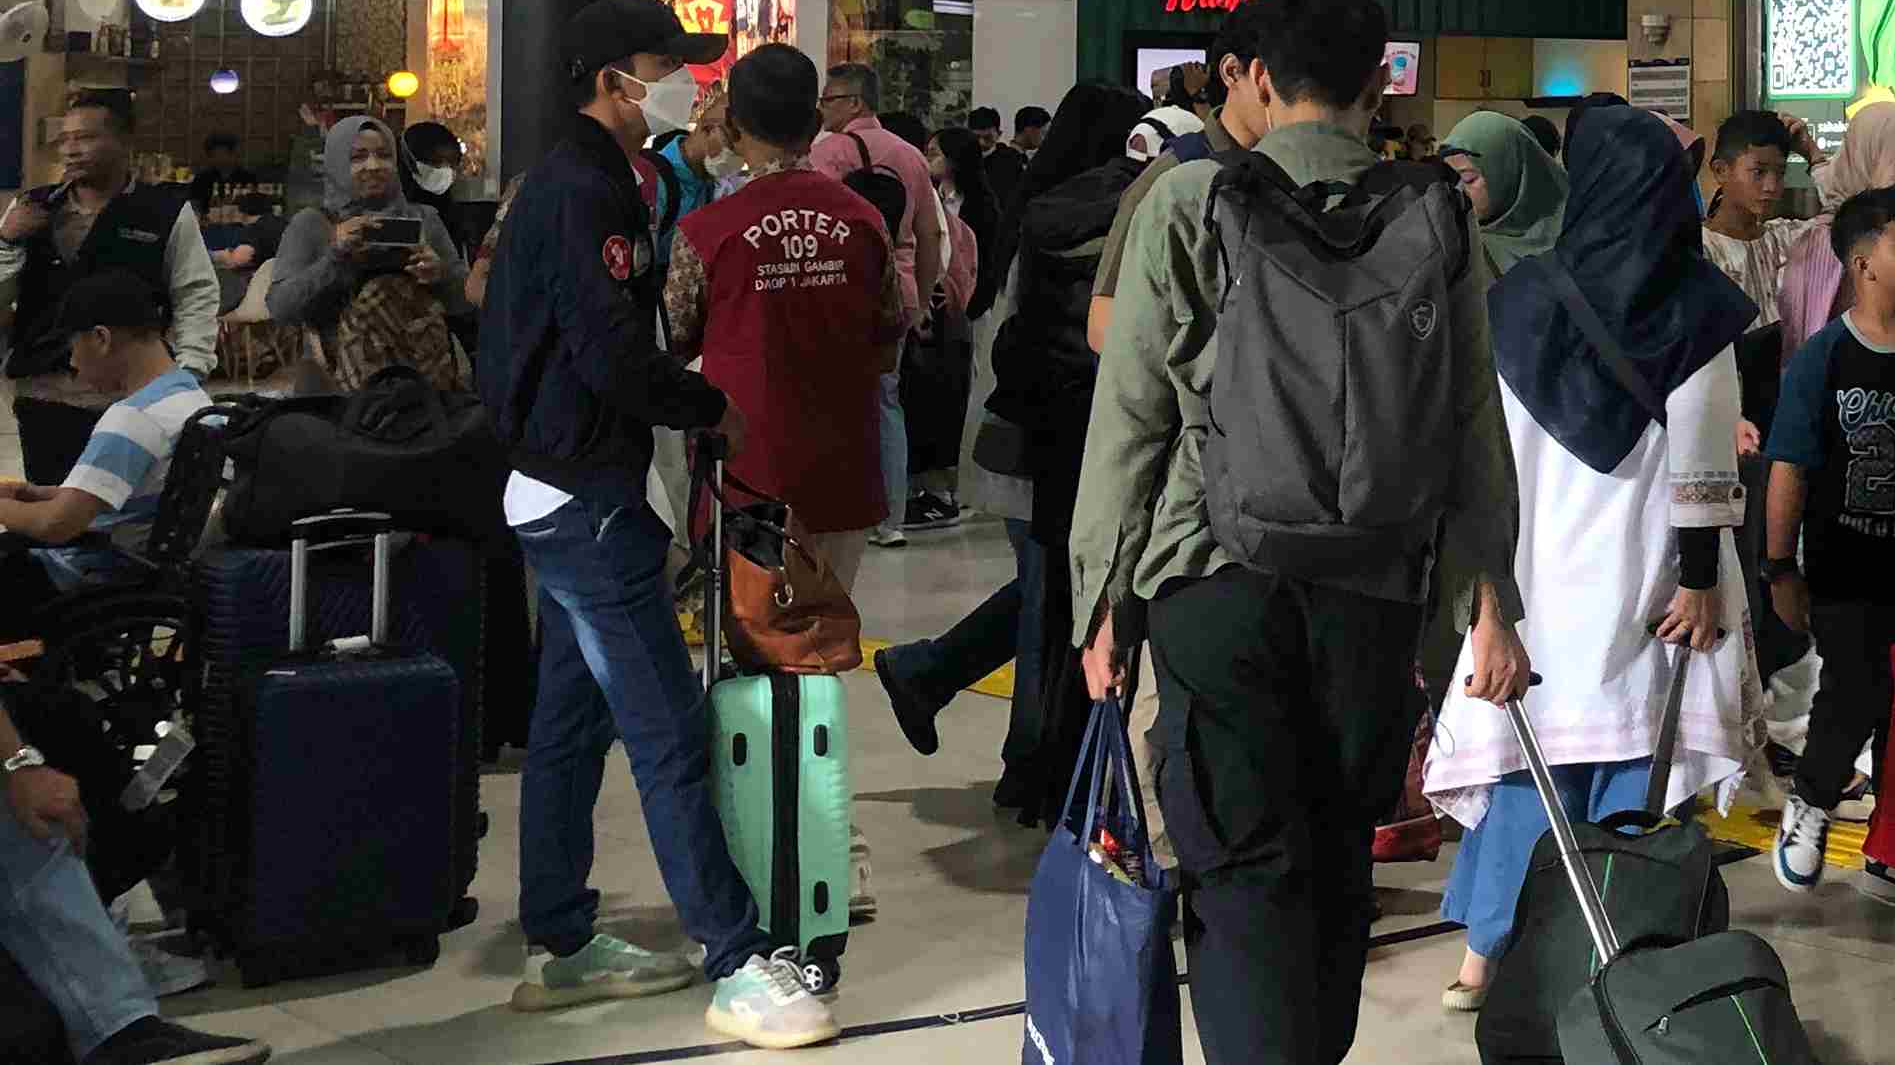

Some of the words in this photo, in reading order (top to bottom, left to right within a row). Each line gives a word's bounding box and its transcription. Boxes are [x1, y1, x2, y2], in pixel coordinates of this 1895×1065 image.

[743, 209, 851, 249] PORTER
[781, 234, 818, 259] 109
[757, 261, 801, 276] STASIUN
[804, 260, 845, 273] GAMBIR
[754, 277, 786, 291] DAOP
[800, 273, 848, 288] JAKARTA
